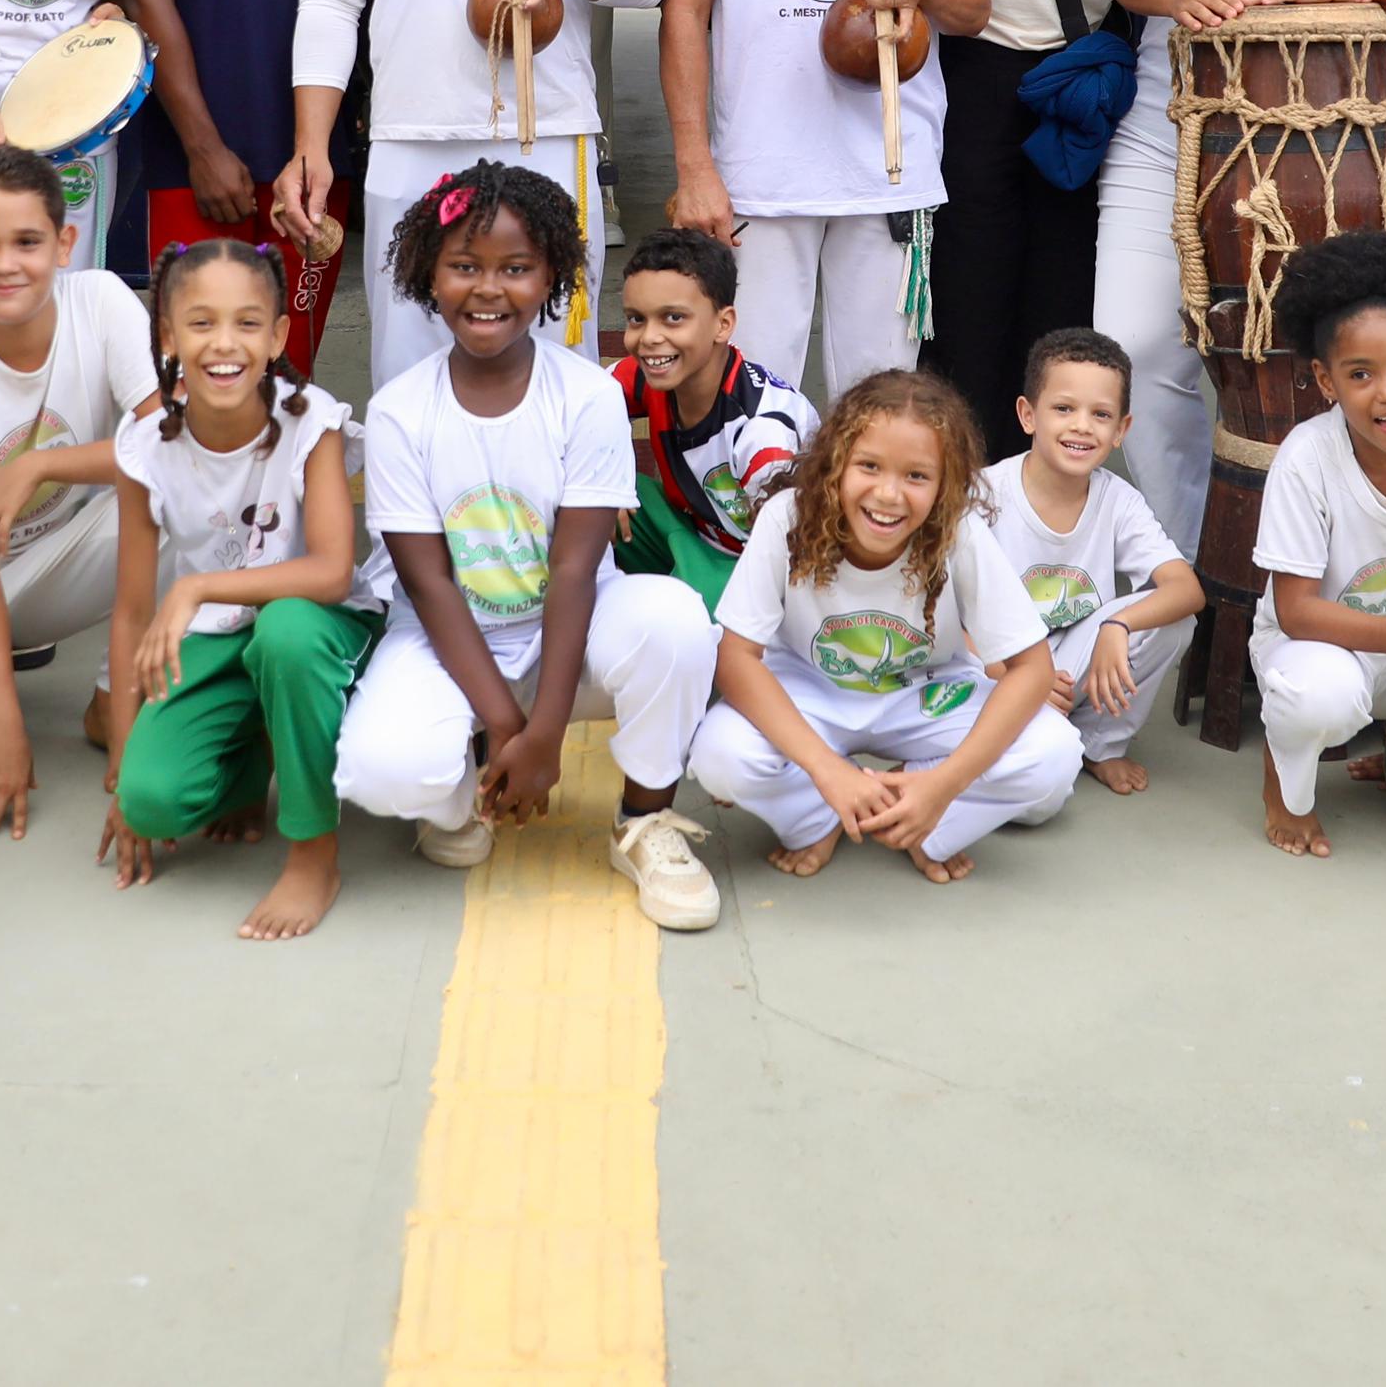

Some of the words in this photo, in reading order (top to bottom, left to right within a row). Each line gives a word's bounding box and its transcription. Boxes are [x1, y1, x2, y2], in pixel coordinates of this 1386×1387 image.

[34, 11, 65, 23] RATO
[779, 8, 790, 18] C.
[451, 489, 488, 520] ESCOLA
[461, 584, 504, 615] MESTRE
[856, 614, 871, 626] DE
[873, 614, 923, 645] CAPOEIRA
